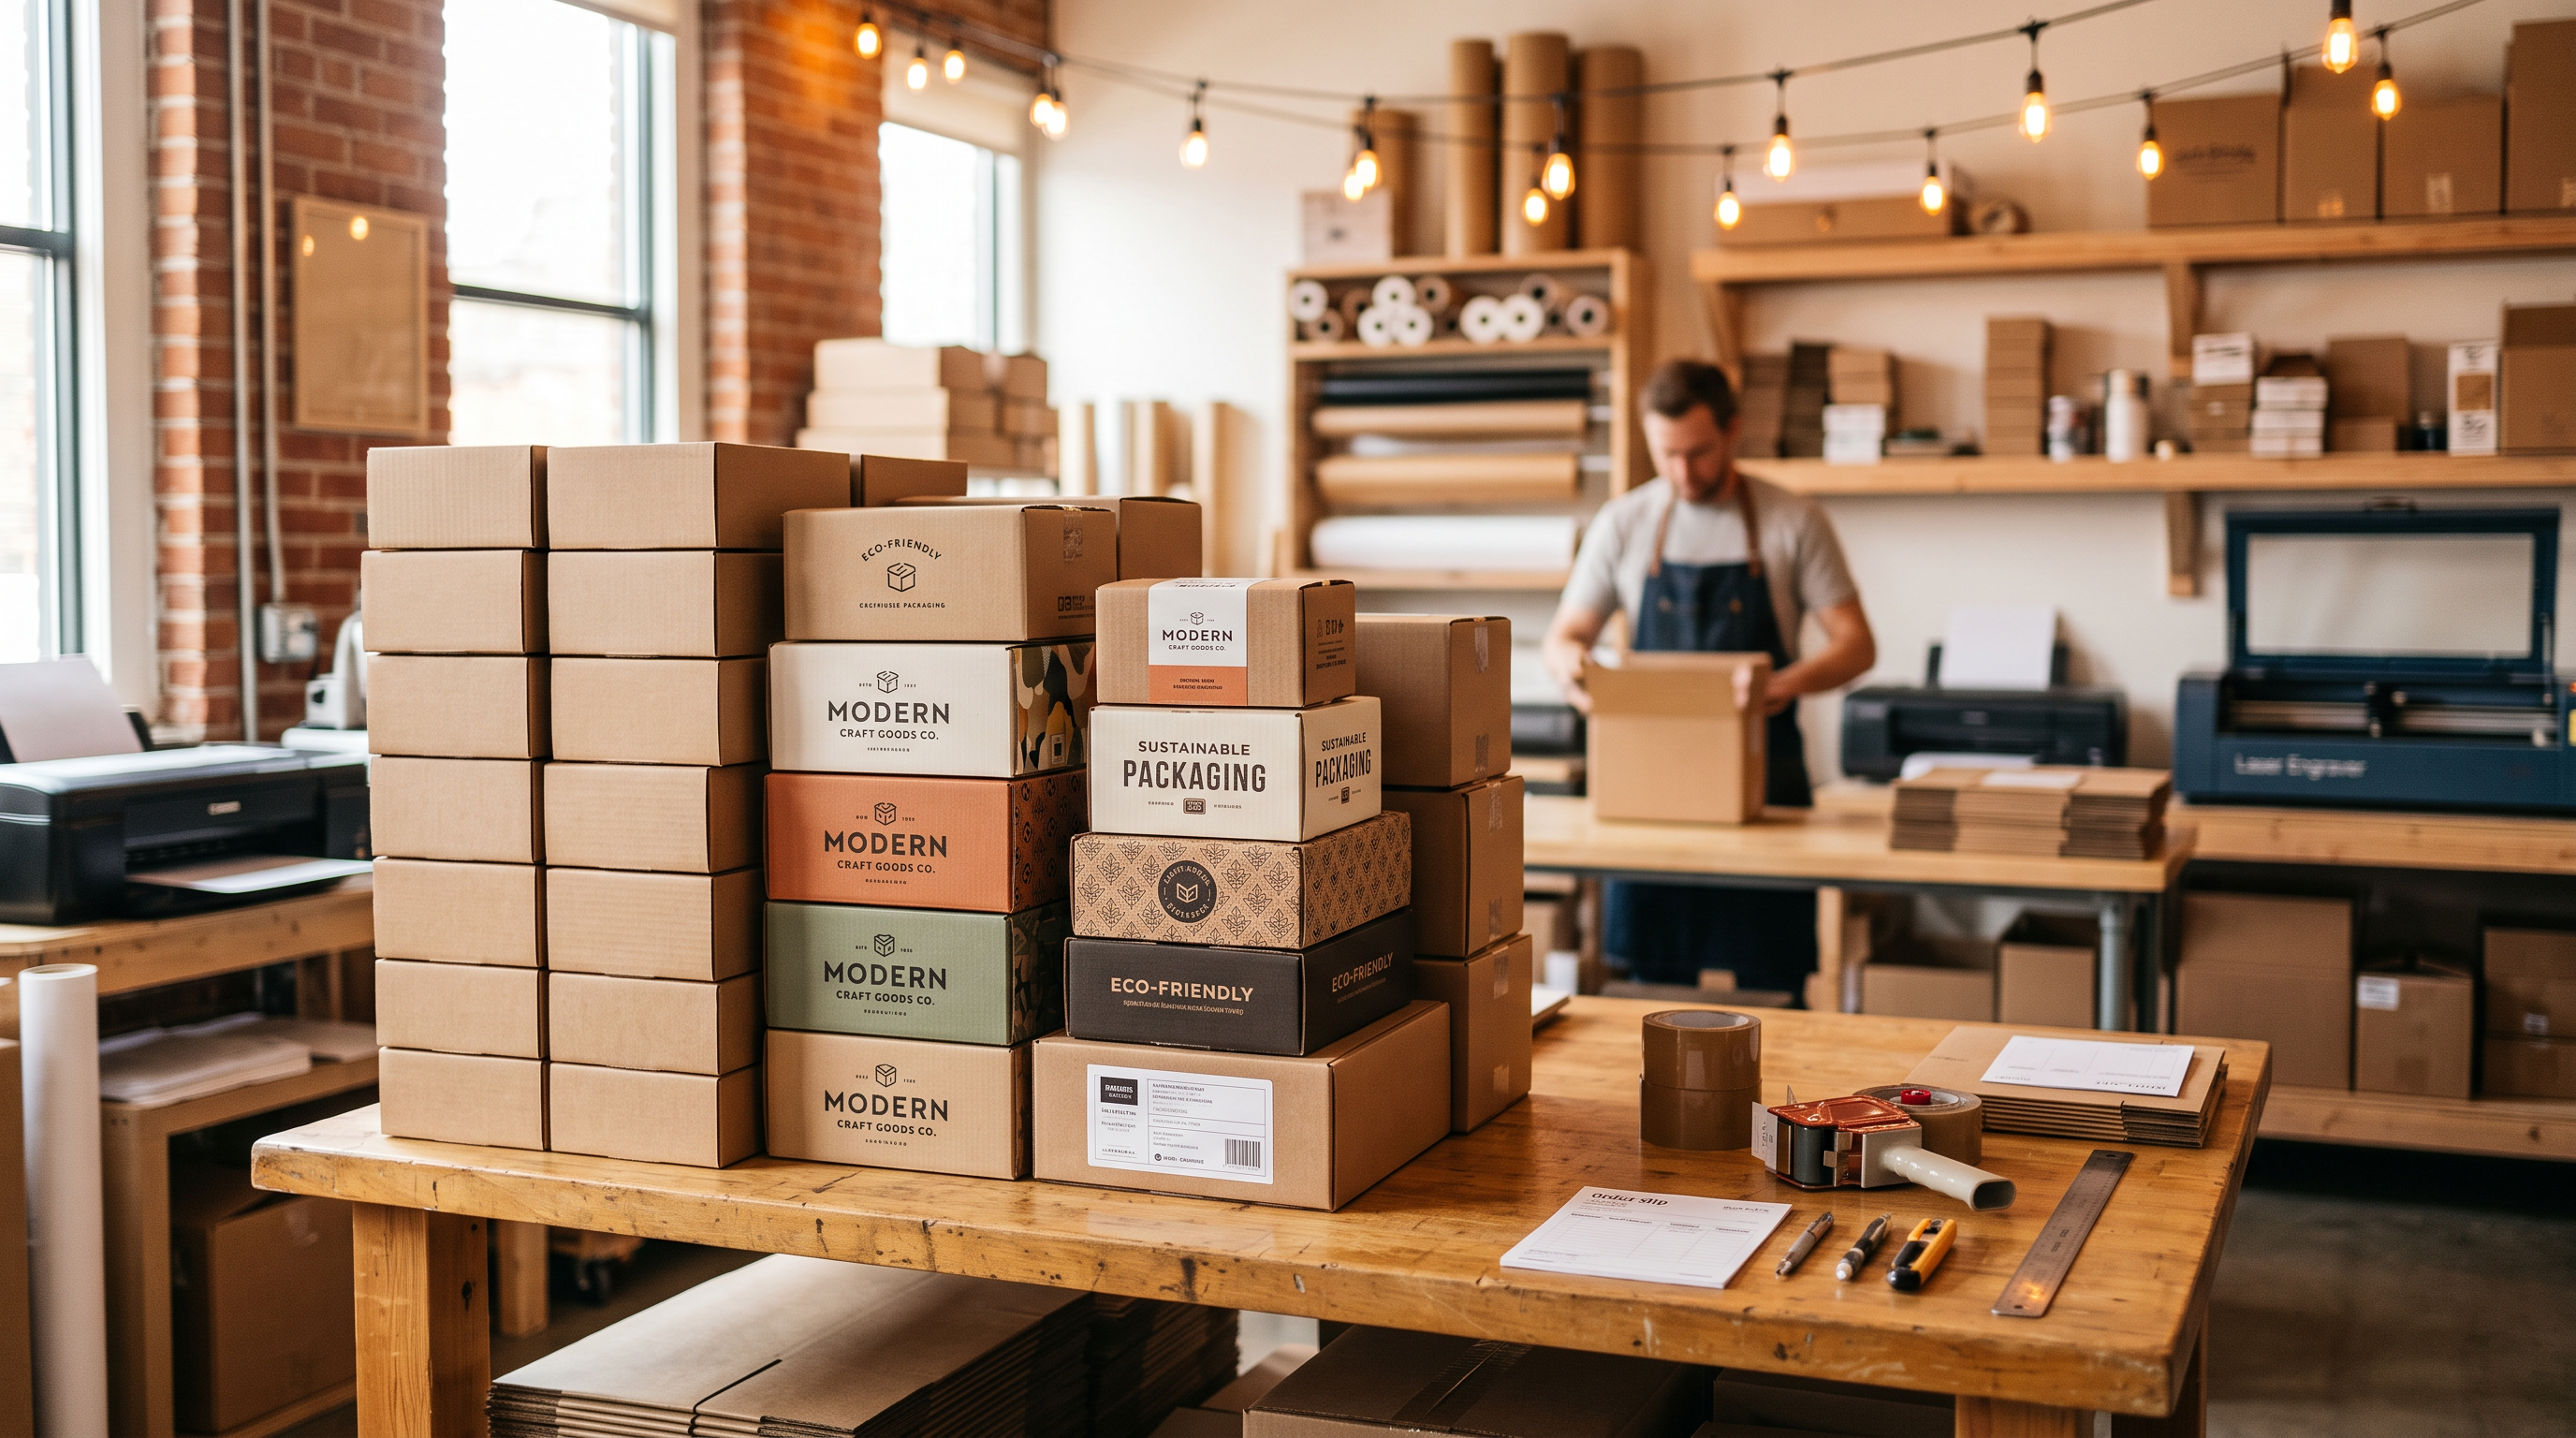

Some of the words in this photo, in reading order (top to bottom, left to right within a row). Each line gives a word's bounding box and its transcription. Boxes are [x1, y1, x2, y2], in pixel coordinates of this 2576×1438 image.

[861, 538, 942, 562] ECO-FRIENDLY
[1162, 629, 1234, 642] MODERN
[827, 700, 950, 725] MODERN
[840, 728, 874, 739] CRAFT
[877, 729, 916, 740] GOODS
[919, 730, 939, 741] CO.
[1322, 732, 1367, 752] SUSTAINABLE
[1138, 741, 1251, 756] SUSTAINABLE
[1123, 759, 1266, 793] PACKAGING
[1315, 748, 1371, 788] PACKAGING
[824, 829, 947, 858] MODERN
[837, 859, 872, 871] CRAFT
[875, 861, 914, 873] GOODS
[916, 863, 936, 874] CO.
[824, 960, 946, 990] MODERN
[1331, 951, 1394, 993] ECO-FRIENDLY
[836, 990, 871, 1001] CRAFT
[874, 992, 914, 1005] GOODS
[916, 995, 935, 1006] CO.
[1110, 976, 1254, 1003] ECO-FRIENDLY
[824, 1089, 948, 1121] MODERN
[837, 1119, 872, 1132] CRAFT
[875, 1123, 915, 1135] GOODS
[917, 1126, 937, 1137] CO.
